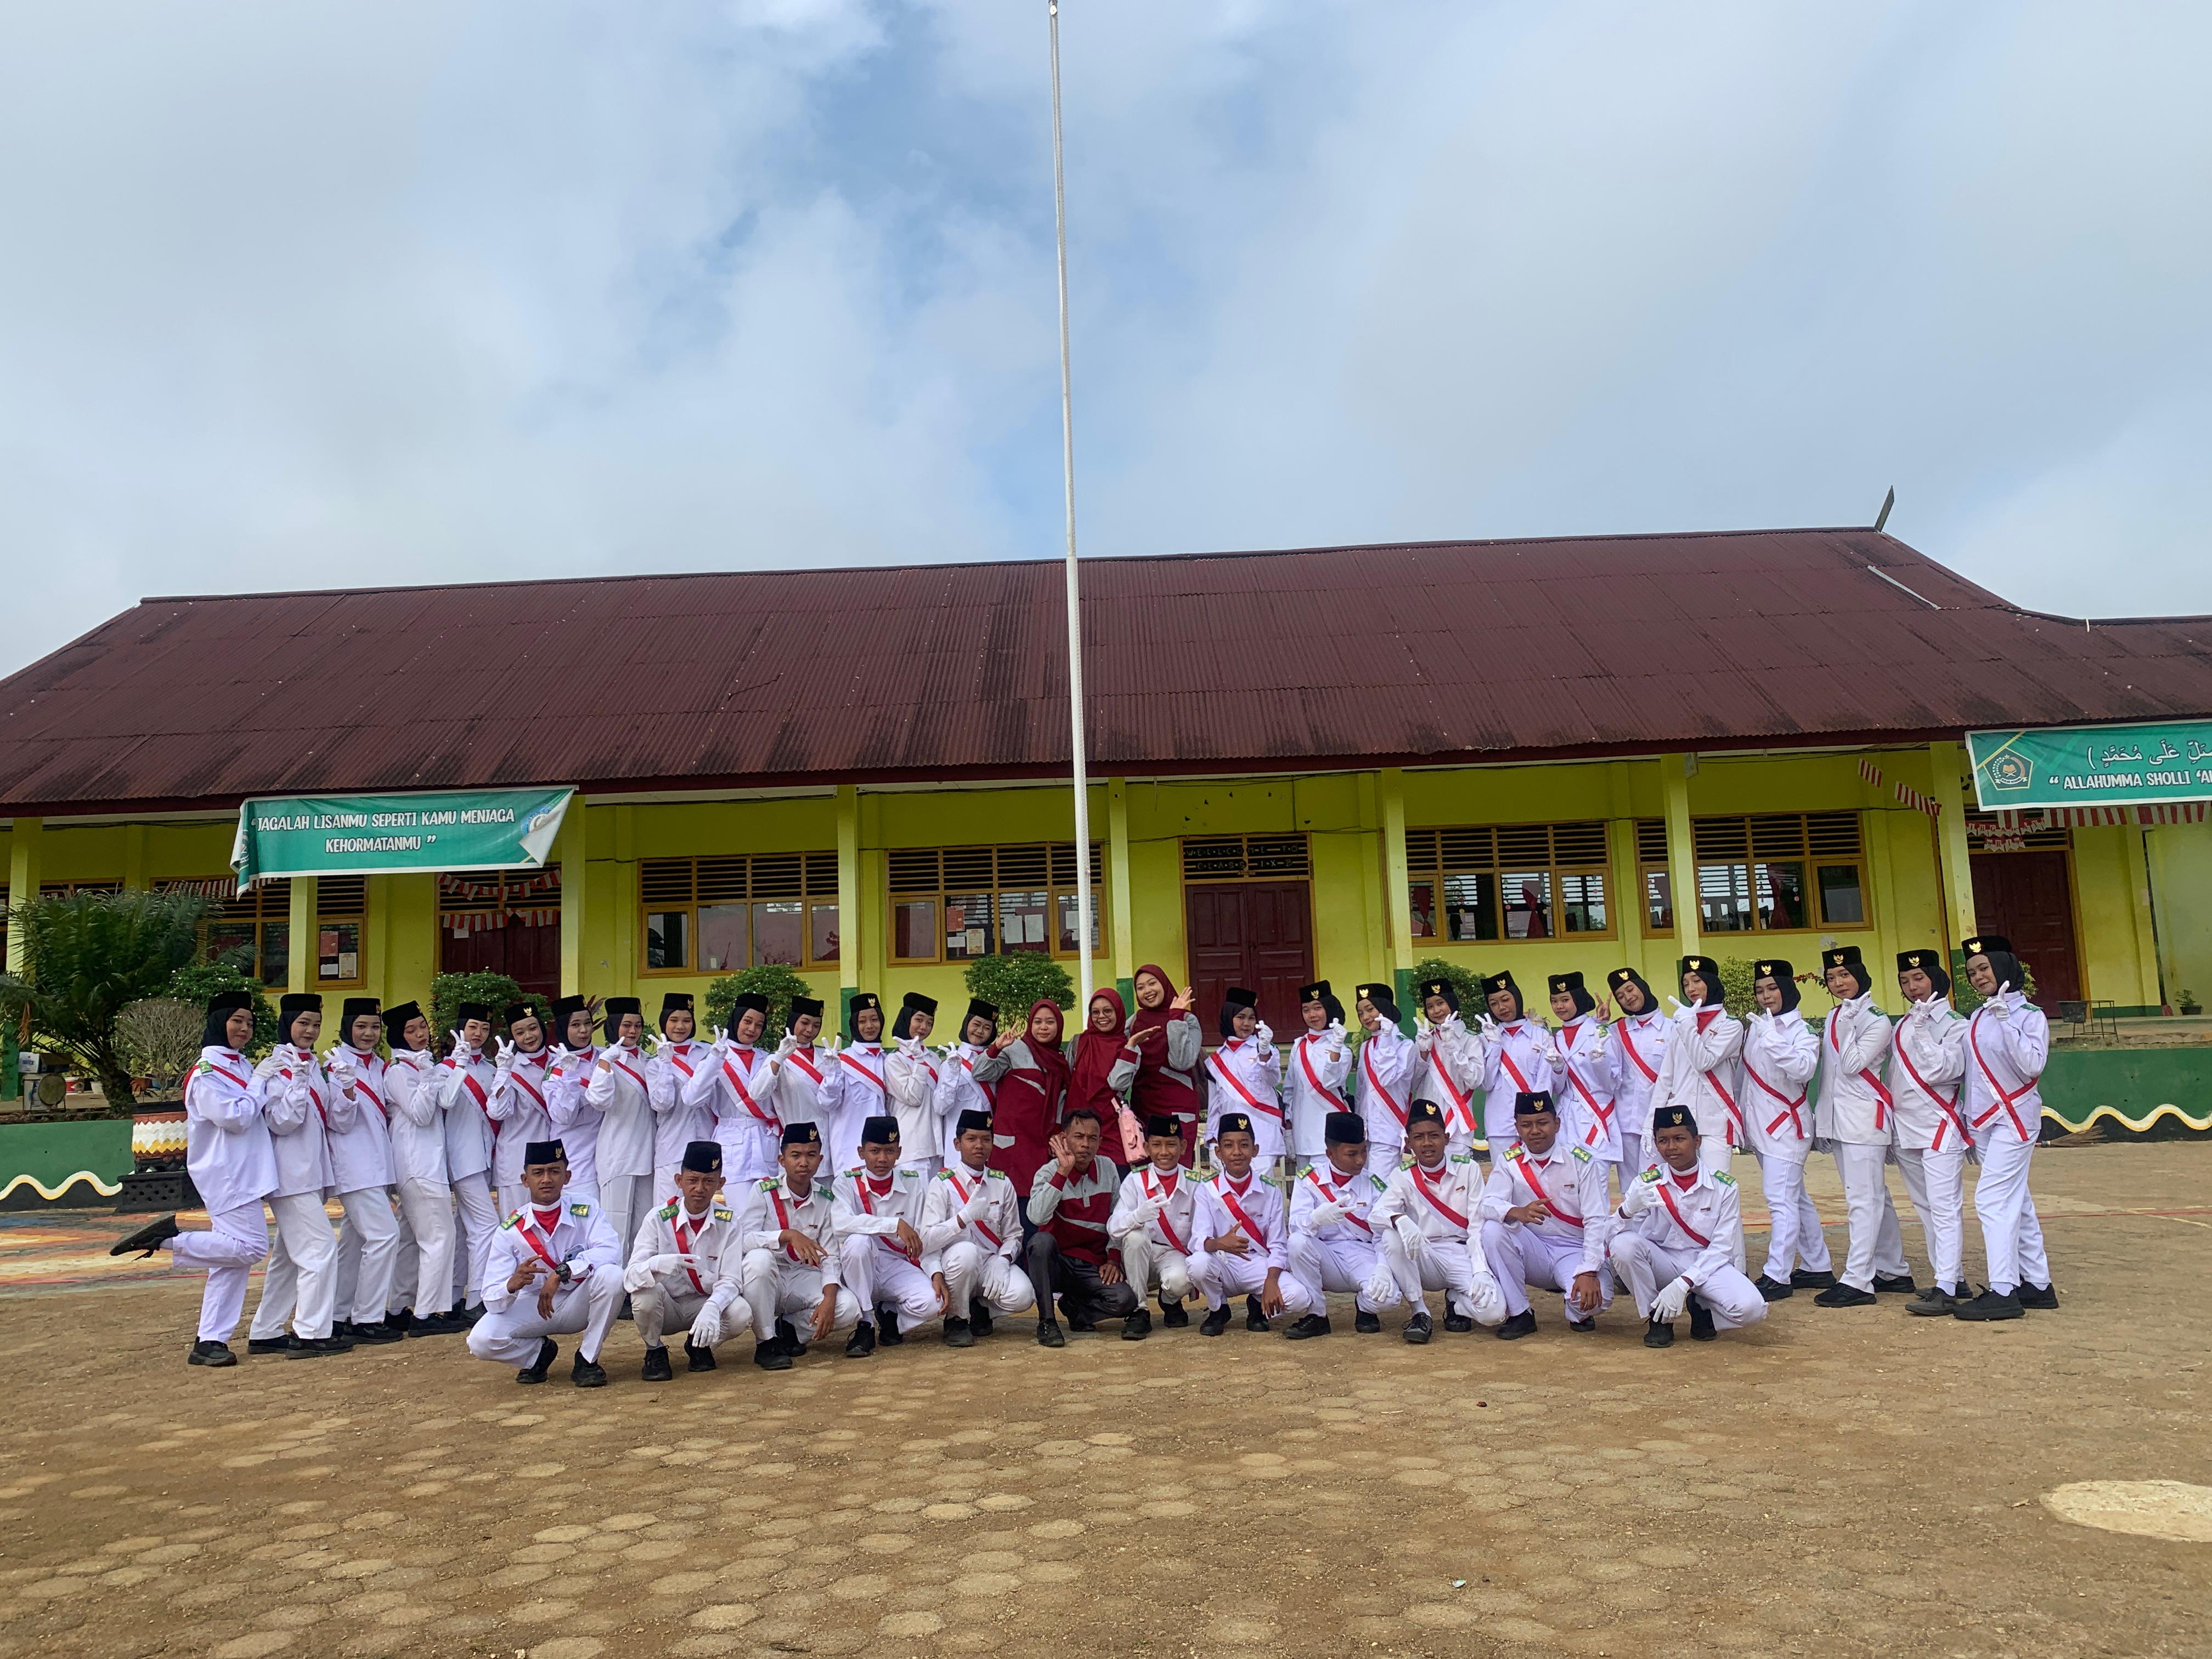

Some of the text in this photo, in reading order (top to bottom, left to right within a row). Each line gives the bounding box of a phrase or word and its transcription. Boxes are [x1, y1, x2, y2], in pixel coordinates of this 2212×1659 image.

[2063, 772, 2143, 790] ALLAHUMMA
[2146, 770, 2192, 787] SHOLLI
[313, 814, 368, 830] LISANMU
[371, 812, 417, 827] SEPERTI
[421, 810, 457, 826] KAMU
[460, 808, 515, 824] MENJAGA
[325, 835, 421, 853] KEHORMATANMU
